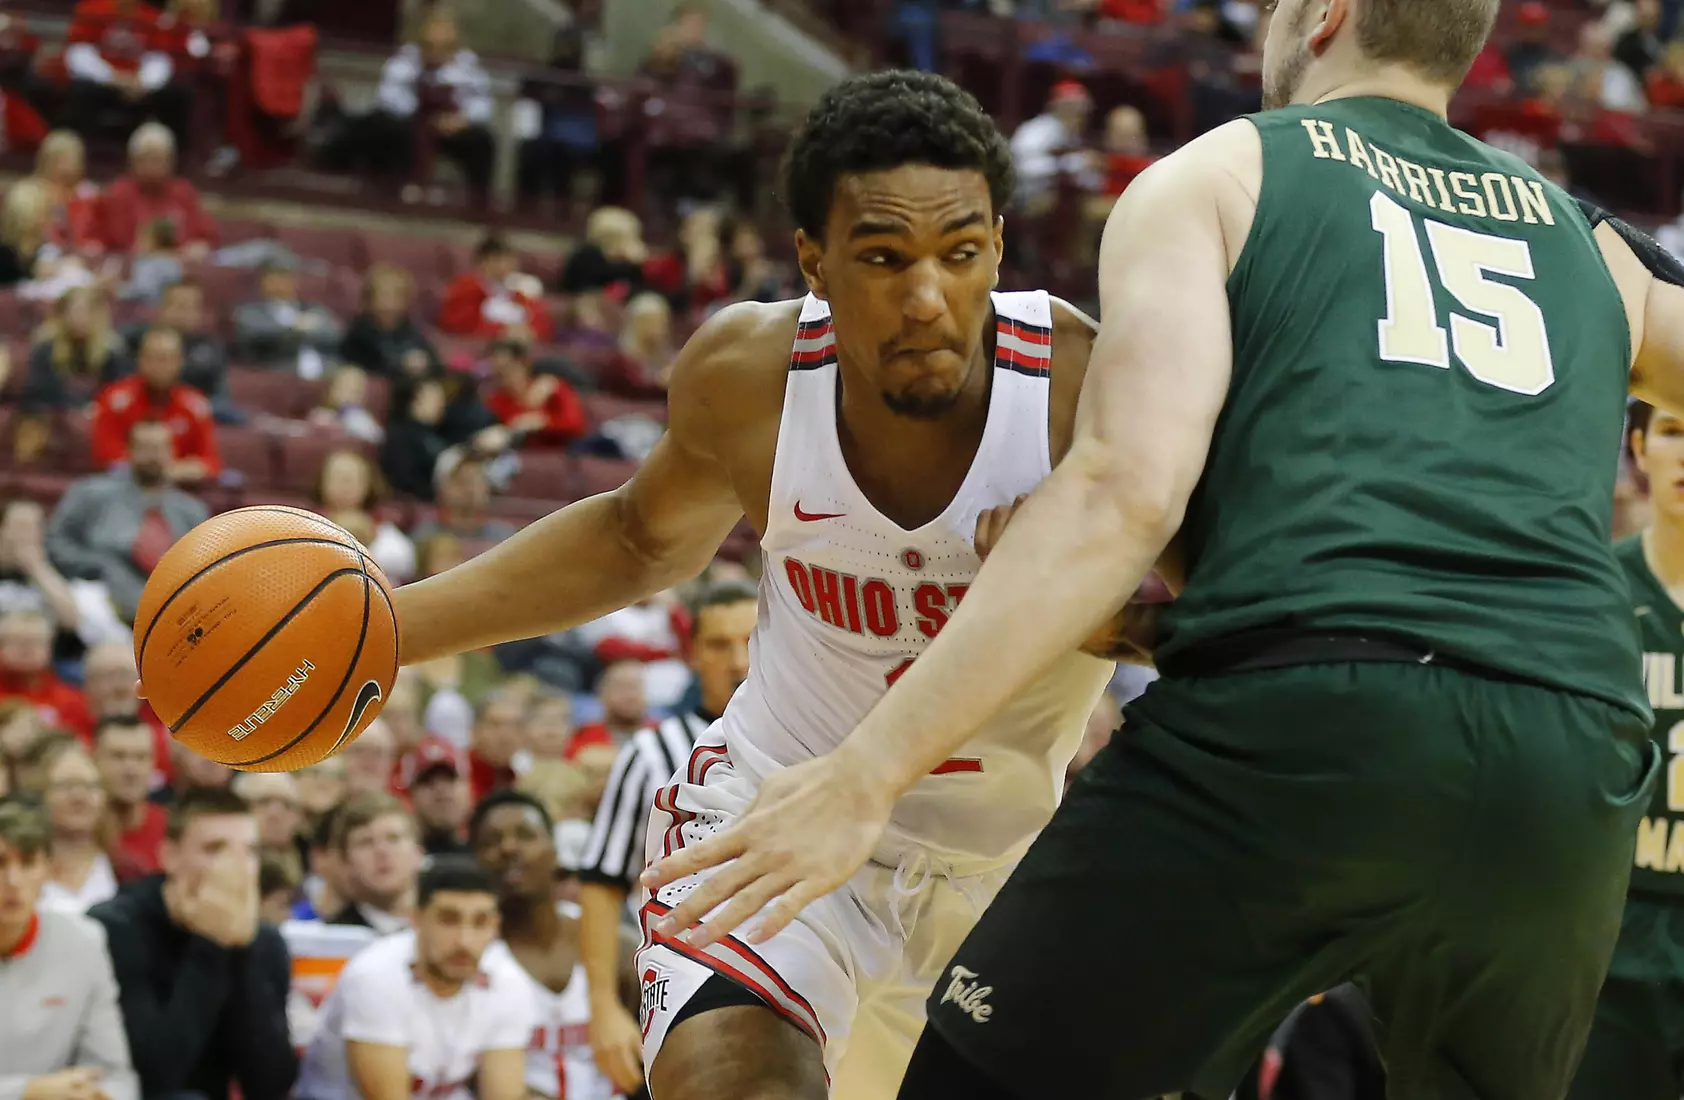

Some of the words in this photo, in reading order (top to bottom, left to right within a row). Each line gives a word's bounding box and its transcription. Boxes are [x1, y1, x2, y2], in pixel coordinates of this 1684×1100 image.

[1301, 119, 1556, 226] HARRISON
[1370, 189, 1555, 396] 15
[784, 556, 901, 637] OHIO
[227, 658, 316, 741] HYPERELITE
[940, 965, 993, 1023] Tribe
